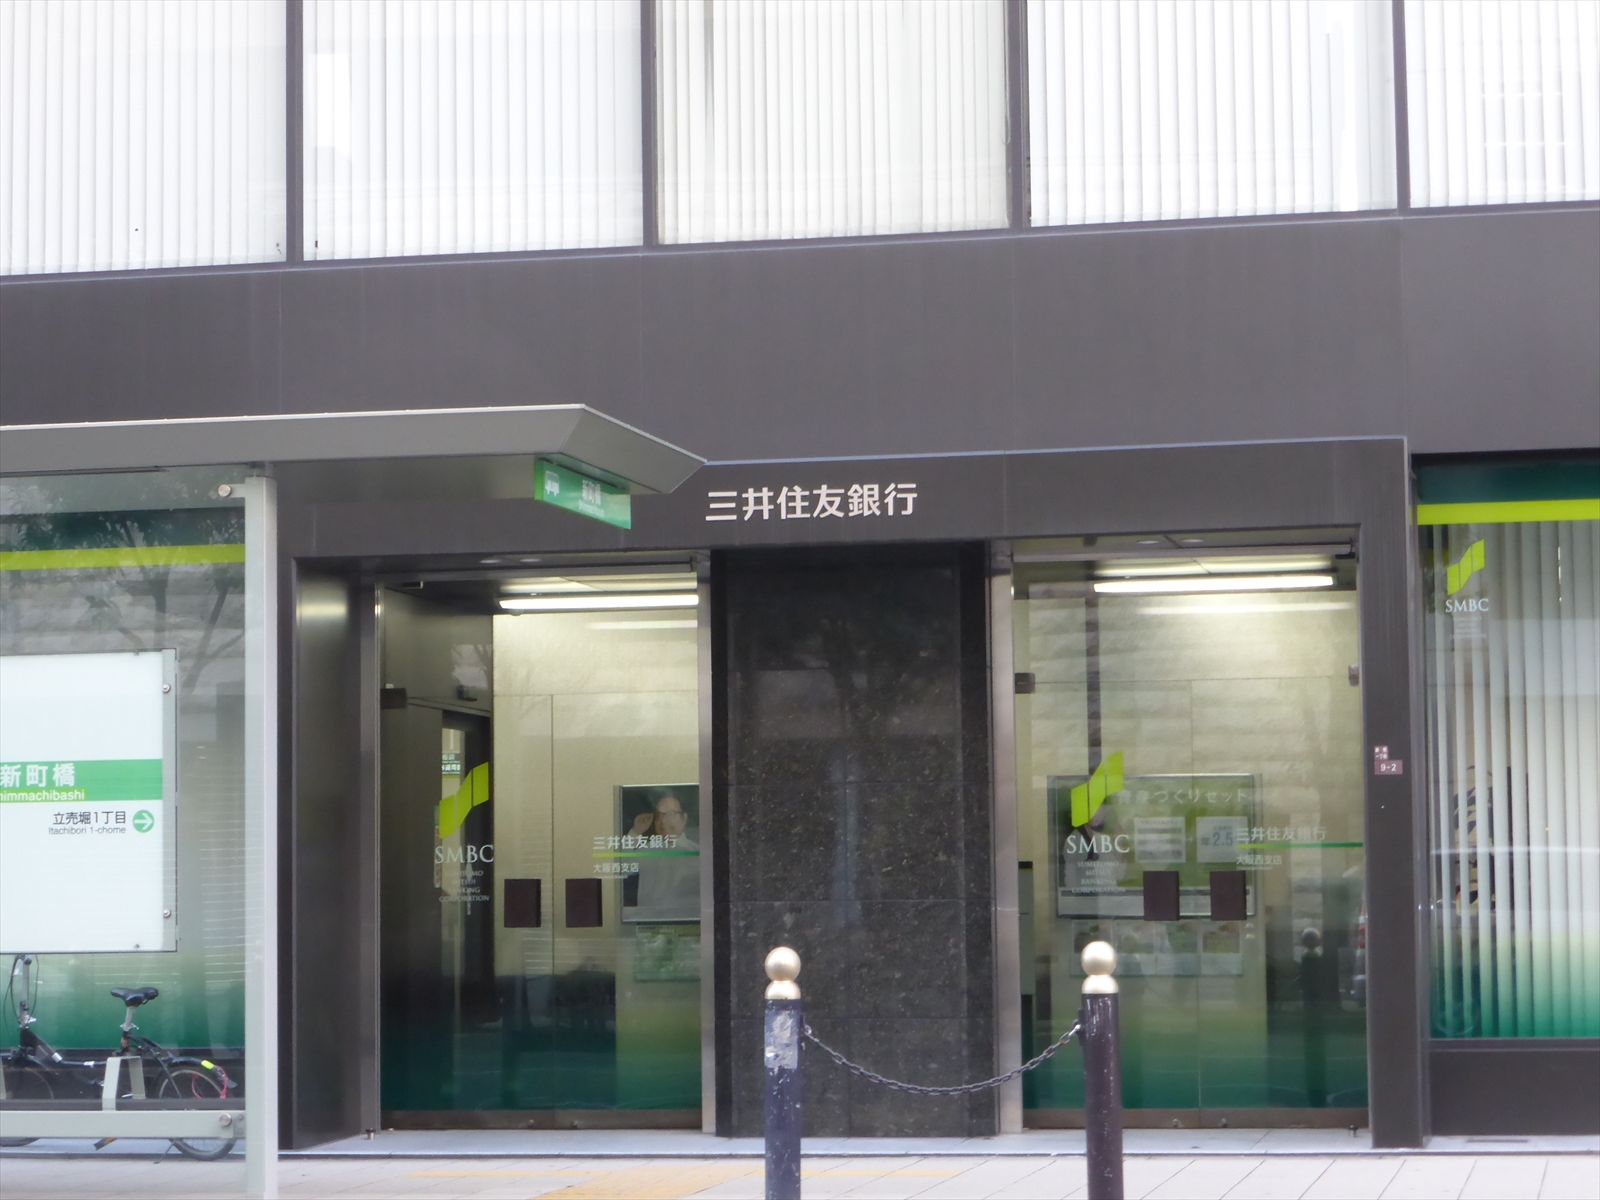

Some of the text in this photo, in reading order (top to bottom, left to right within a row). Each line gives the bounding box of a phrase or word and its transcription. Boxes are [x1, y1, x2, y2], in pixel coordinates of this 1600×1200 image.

[705, 483, 918, 521] 三井住友銀行
[1445, 598, 1489, 614] SMBC
[0, 762, 76, 788] 新町橋
[1380, 763, 1397, 772] 9-2
[53, 811, 126, 825] 立売堀1丁目
[48, 825, 126, 835] Itachibori 1-chome
[1236, 826, 1328, 842] 三井住友銀行
[592, 834, 678, 850] 三井住友銀行
[1066, 834, 1130, 854] SMBC
[434, 845, 495, 864] SMBC
